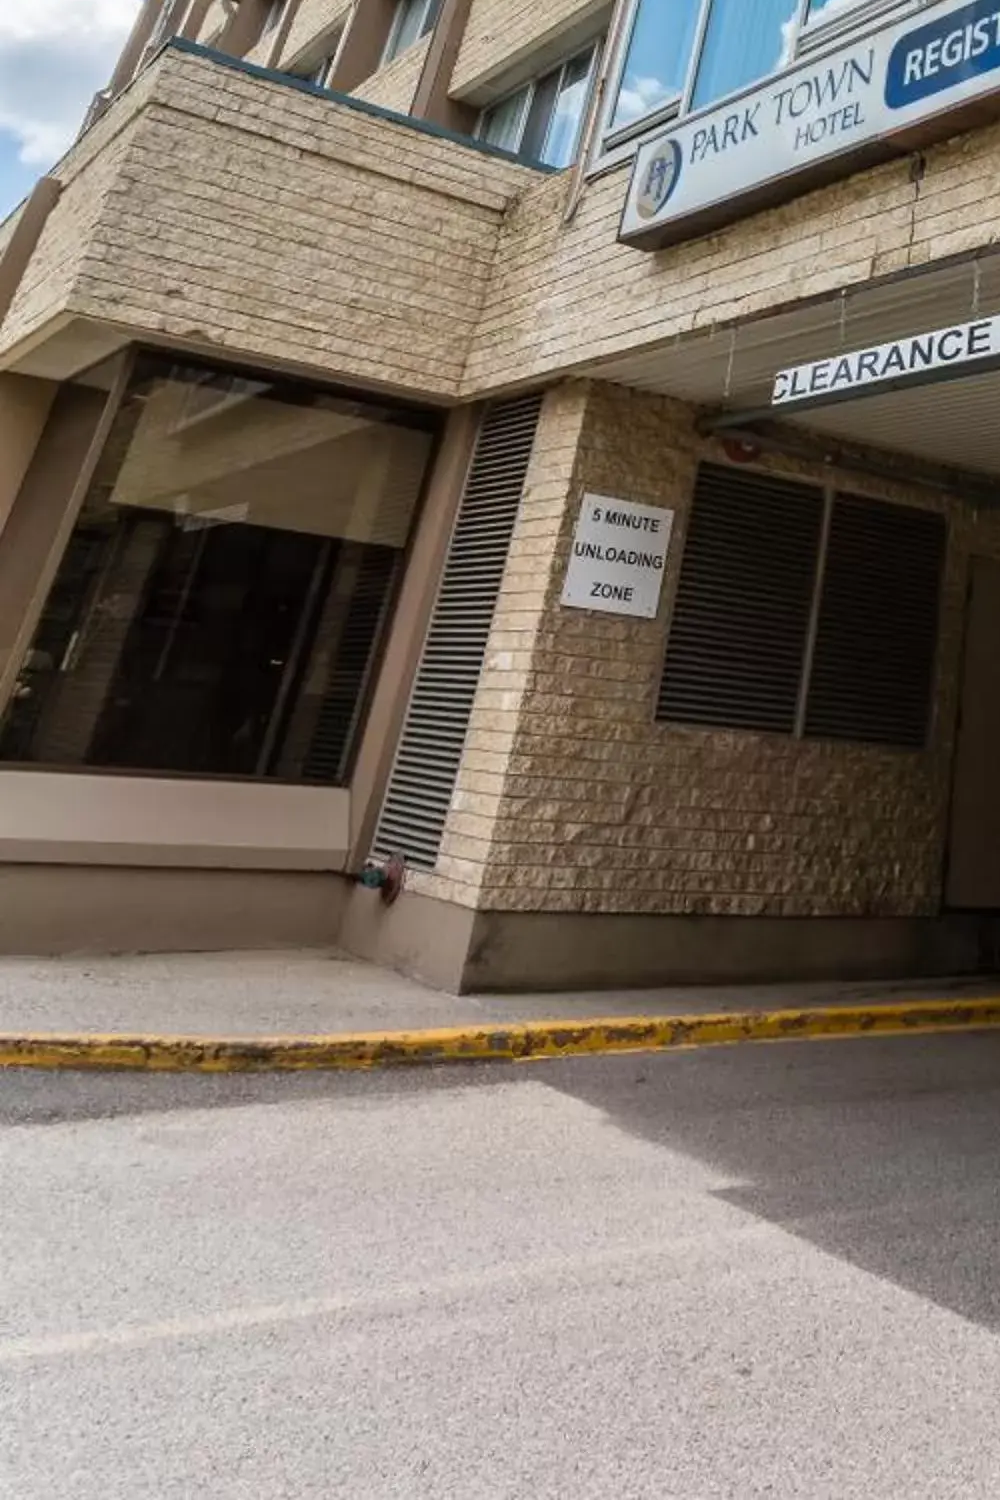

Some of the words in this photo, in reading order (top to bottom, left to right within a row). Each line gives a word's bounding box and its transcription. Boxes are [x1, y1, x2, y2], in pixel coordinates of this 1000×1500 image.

[689, 102, 761, 164] PARK
[773, 48, 875, 125] TOWN
[793, 101, 865, 151] HOTEL
[773, 321, 993, 400] CLEARANCE
[592, 507, 603, 522] 5
[605, 509, 661, 533] MINUTE
[574, 541, 663, 569] UNLOADING
[590, 581, 634, 602] ZONE
